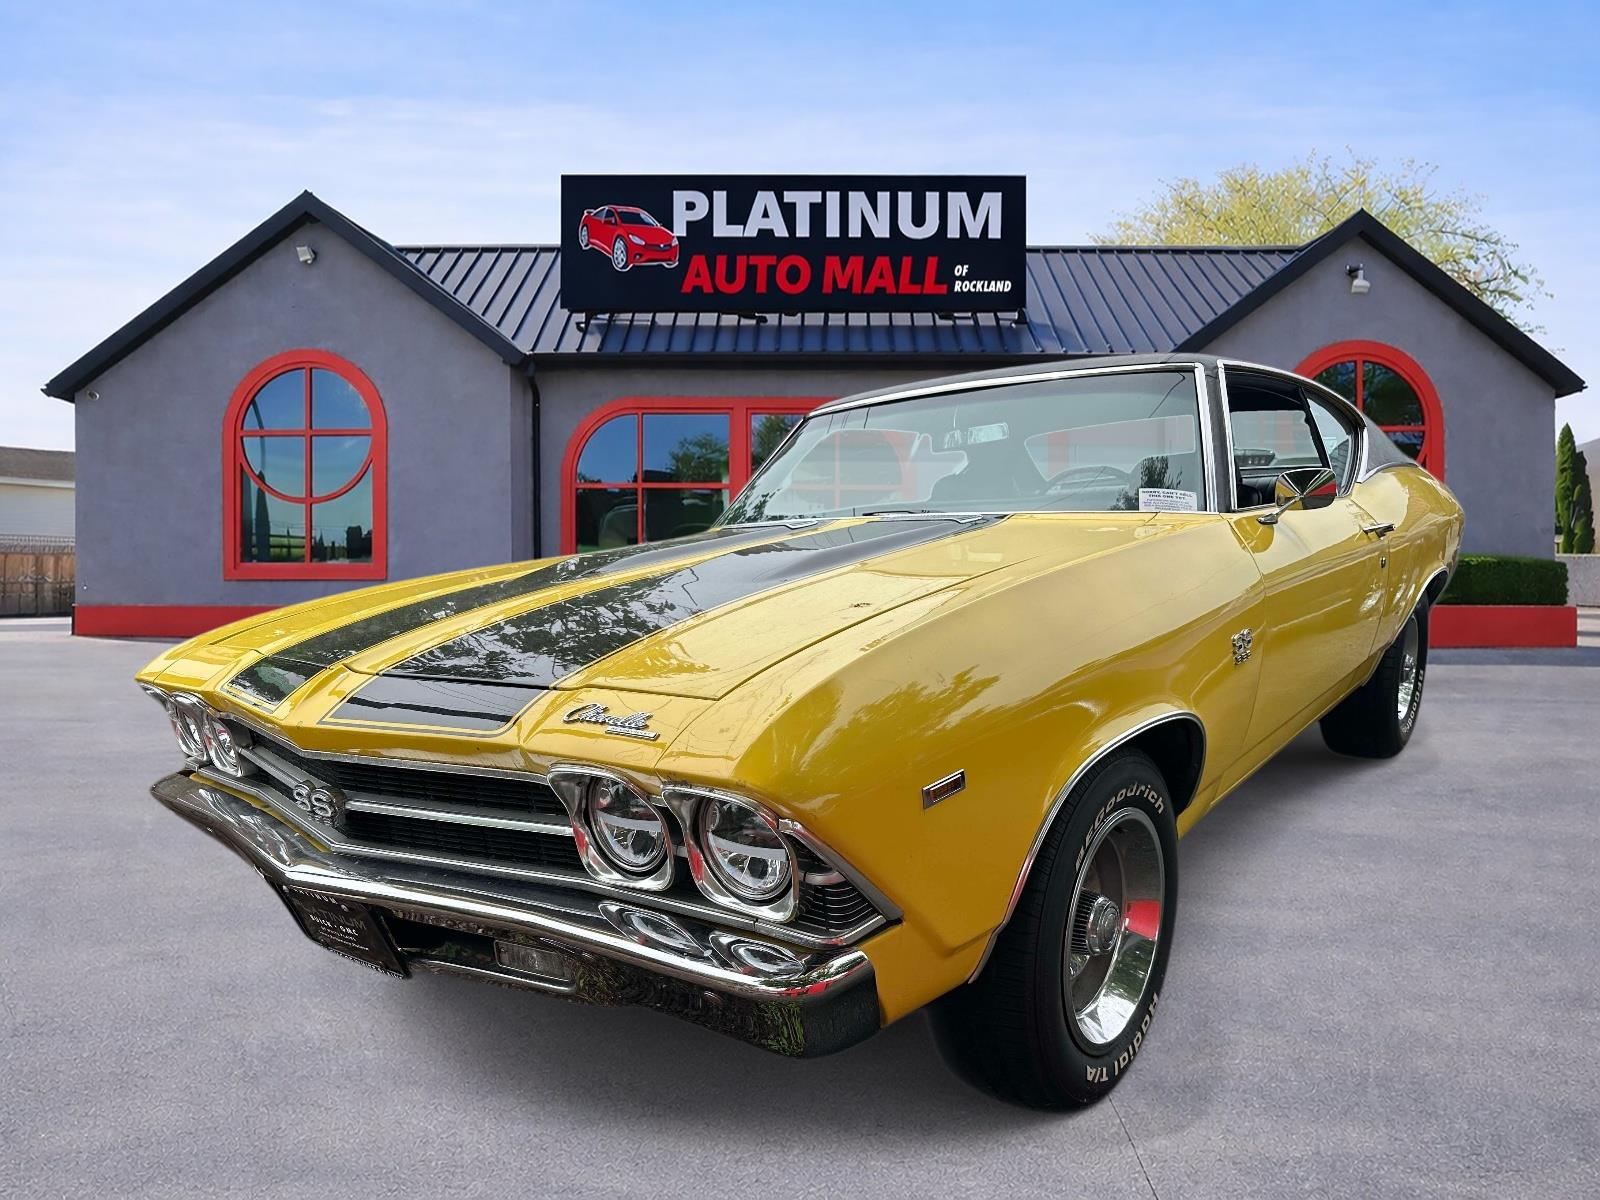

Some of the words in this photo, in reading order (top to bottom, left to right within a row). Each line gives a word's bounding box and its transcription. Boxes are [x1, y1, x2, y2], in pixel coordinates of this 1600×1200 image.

[672, 190, 1001, 239] PLATINUM
[681, 255, 811, 294] AUTO
[822, 256, 948, 295] MALL
[954, 265, 969, 277] OF
[954, 280, 1012, 293] ROCKLAND
[293, 784, 337, 818] SS
[1114, 992, 1159, 1077] Radial
[1086, 1065, 1108, 1083] T/A
